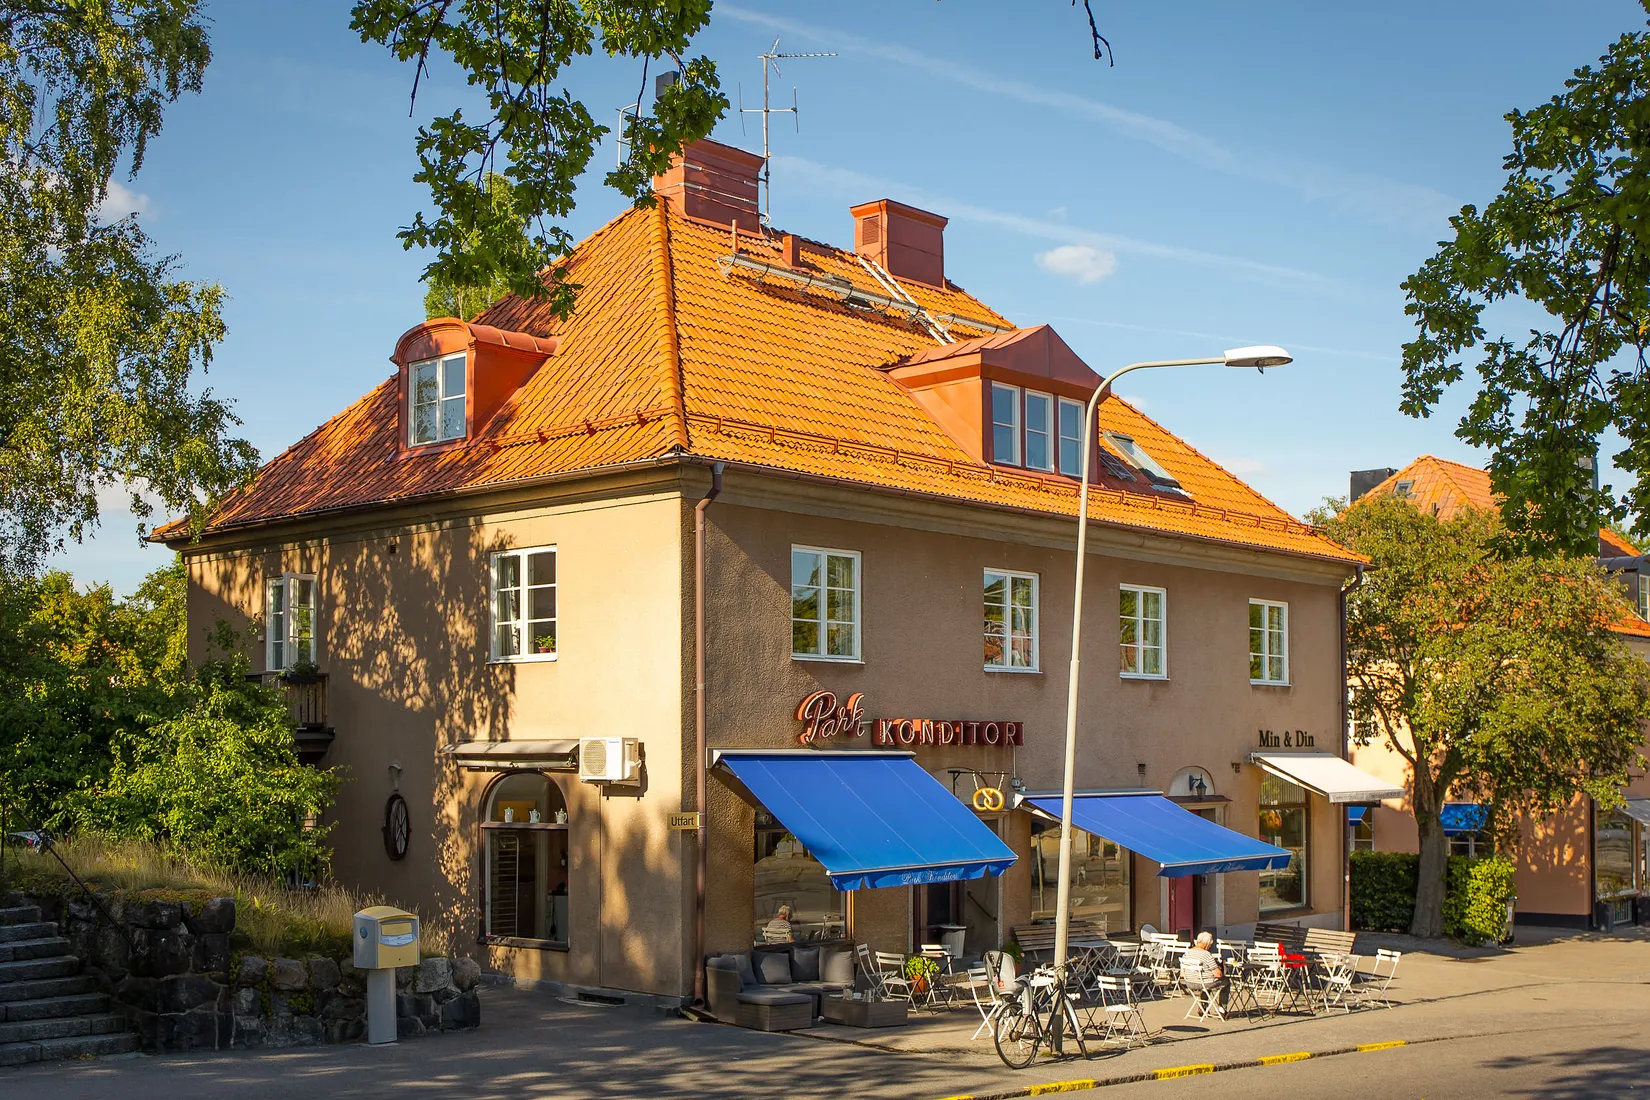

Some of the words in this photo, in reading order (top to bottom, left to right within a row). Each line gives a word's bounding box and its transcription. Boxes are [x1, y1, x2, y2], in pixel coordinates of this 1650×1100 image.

[794, 690, 865, 744] Park
[1259, 730, 1280, 747] Min
[1284, 730, 1292, 747] &
[1296, 730, 1315, 747] Din
[671, 816, 695, 827] Utfart
